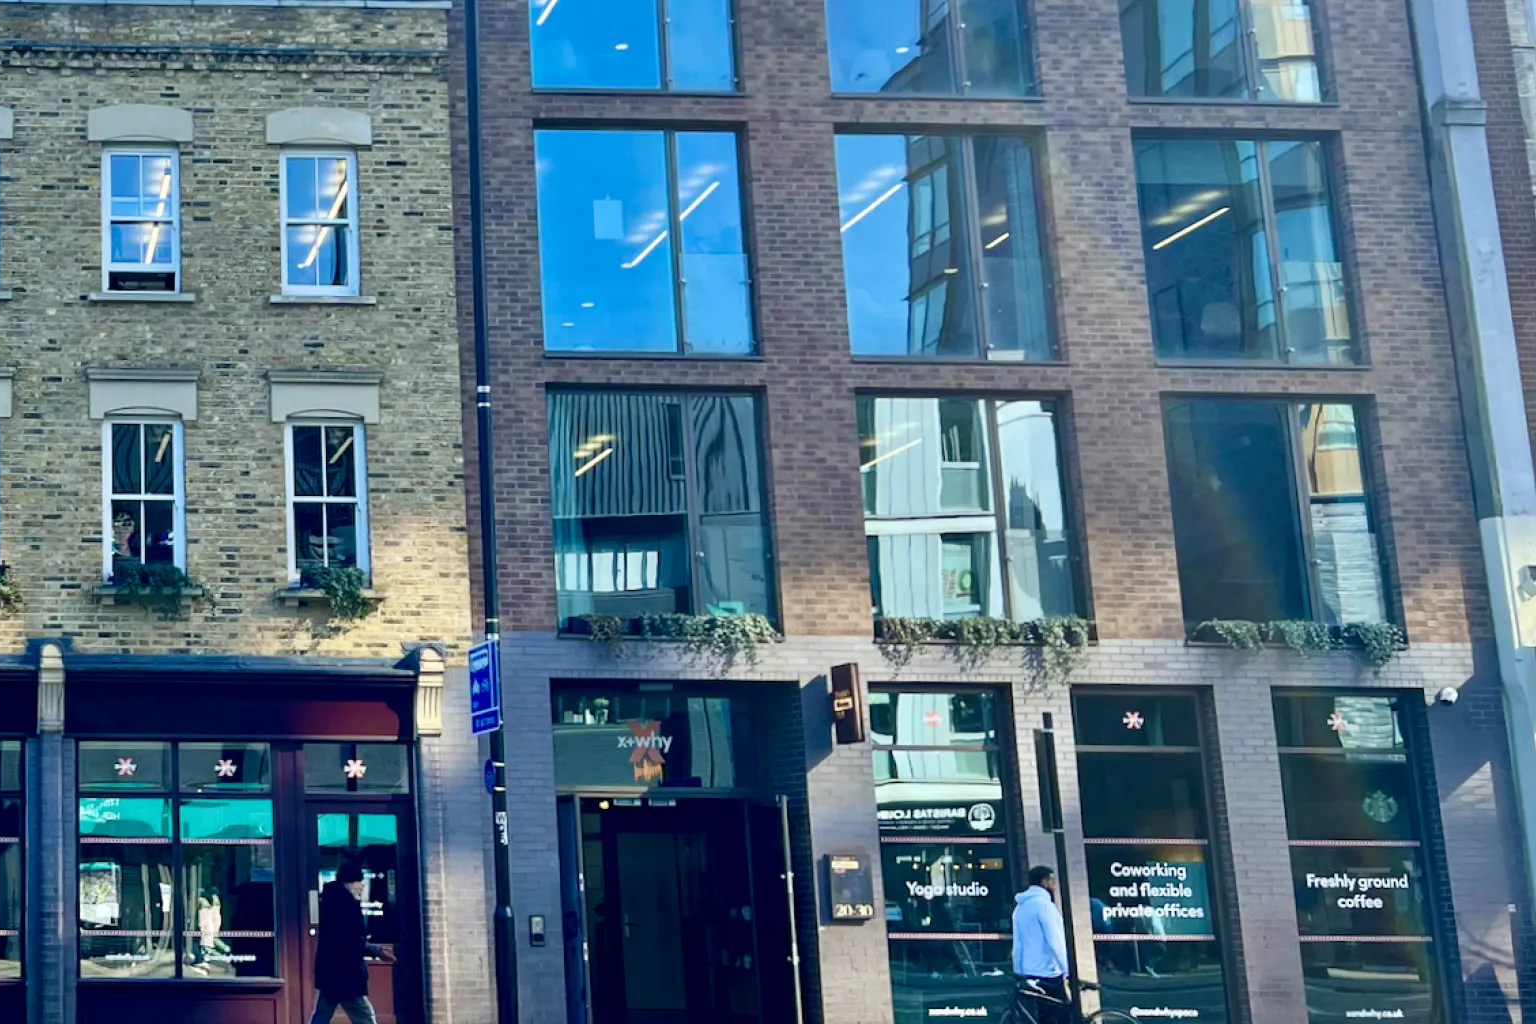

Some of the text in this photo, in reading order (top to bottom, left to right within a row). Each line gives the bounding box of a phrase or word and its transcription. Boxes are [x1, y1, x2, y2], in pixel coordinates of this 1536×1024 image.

[617, 730, 673, 753] x+why
[1110, 861, 1187, 881] Coworking
[906, 881, 989, 900] Yoga studio
[1109, 882, 1193, 898] and flexible
[1306, 873, 1409, 892] Freshly ground
[1337, 894, 1384, 909] coffee
[1102, 902, 1204, 922] private offices
